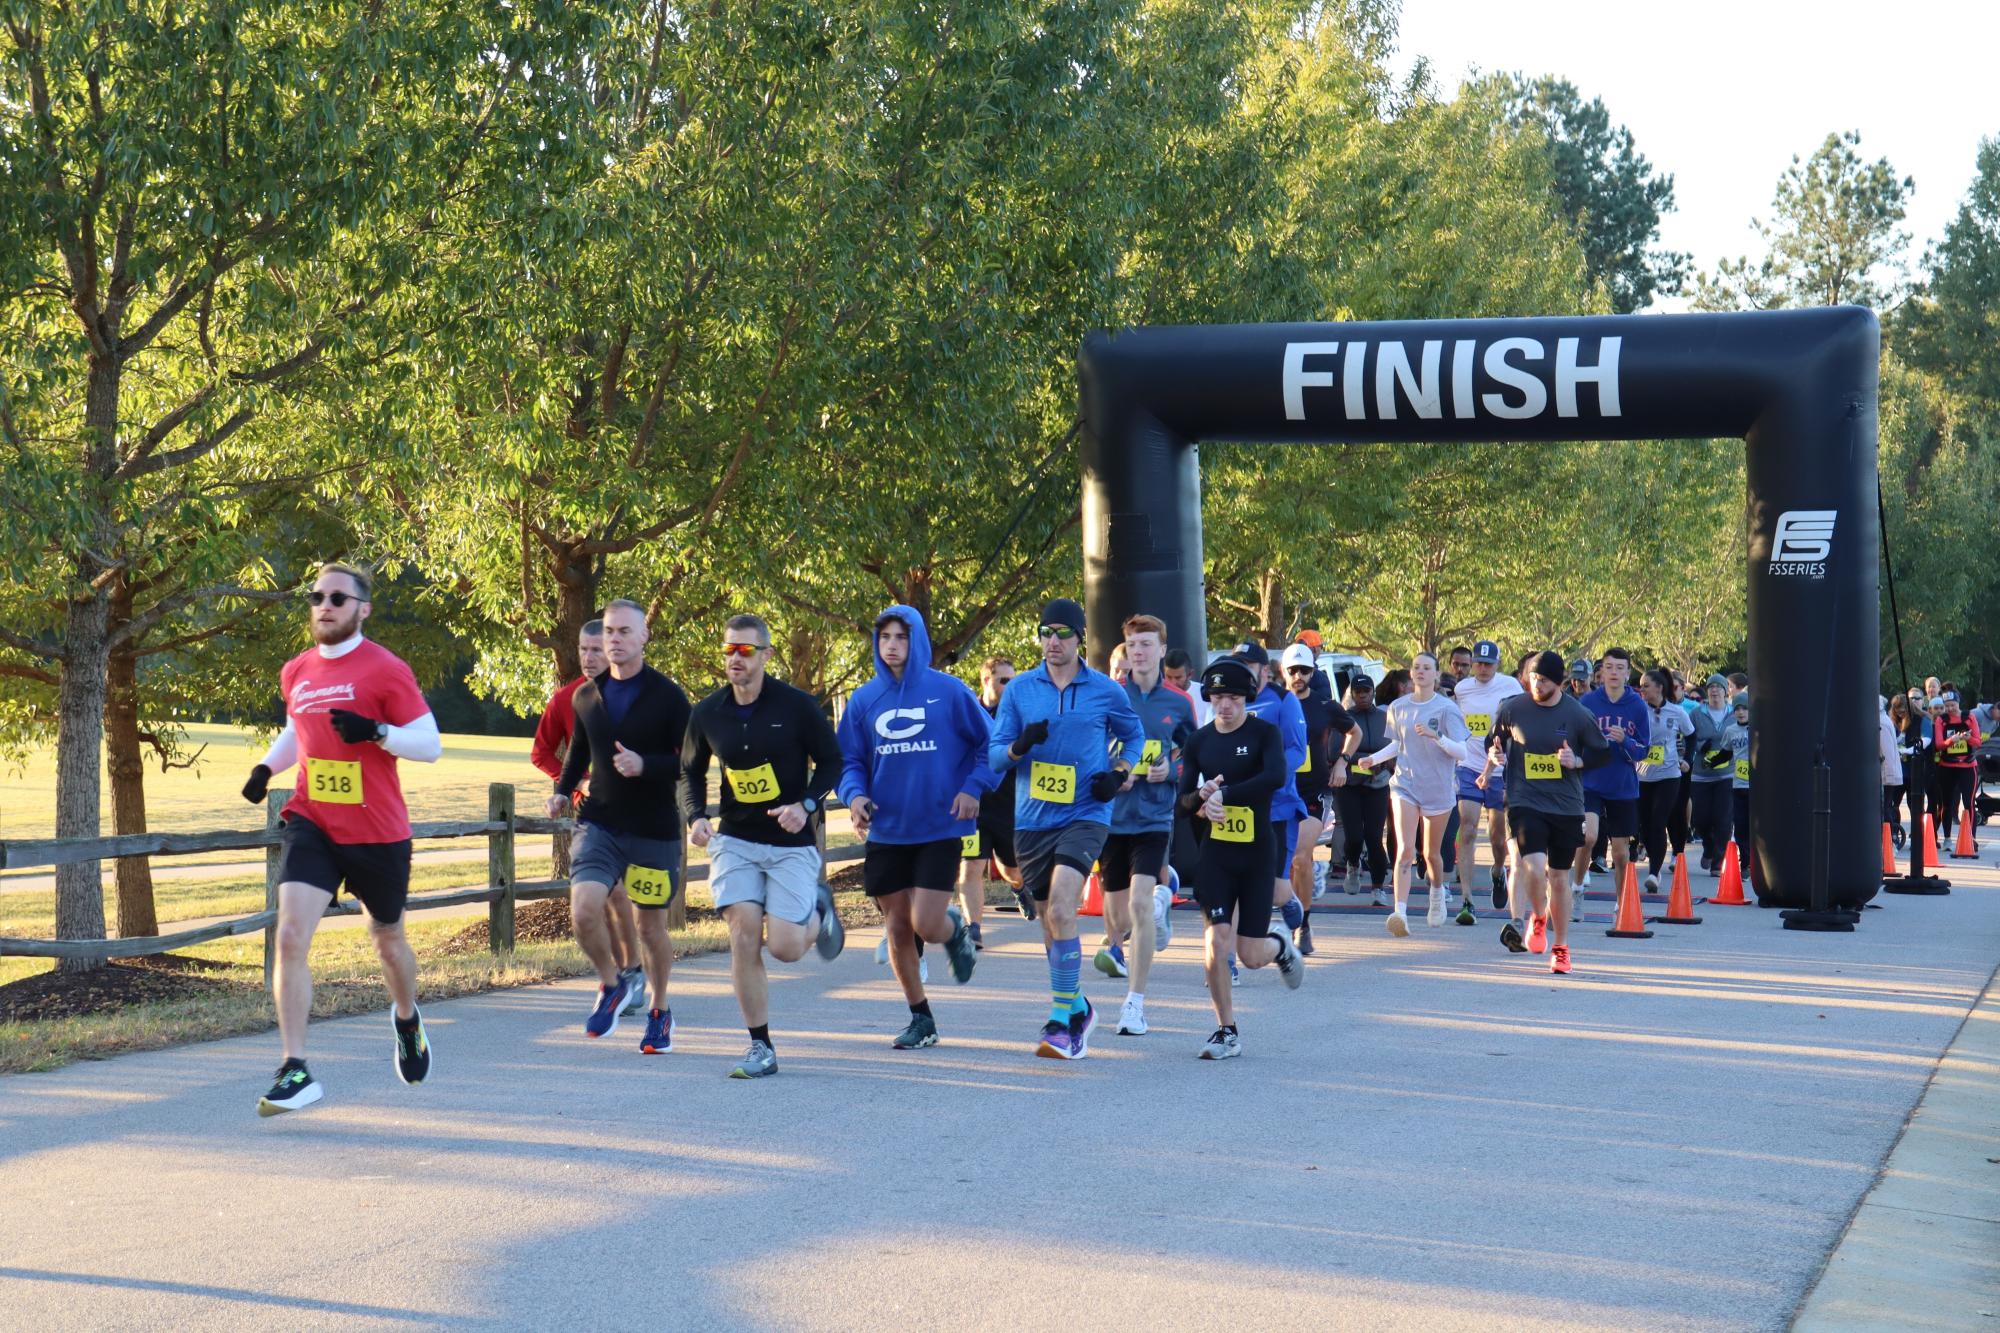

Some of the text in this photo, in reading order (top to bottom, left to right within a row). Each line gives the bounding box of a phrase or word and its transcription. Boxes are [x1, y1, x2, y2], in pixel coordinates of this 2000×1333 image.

[1283, 337, 1622, 420] FINISH
[1768, 563, 1826, 575] FSSERIES
[875, 706, 926, 740] C
[1468, 722, 1487, 731] 521
[1598, 715, 1636, 736] ILLS
[1530, 763, 1555, 773] 498
[315, 774, 352, 793] 518
[737, 779, 770, 795] 502
[1036, 776, 1067, 793] 423
[631, 879, 662, 896] 481
